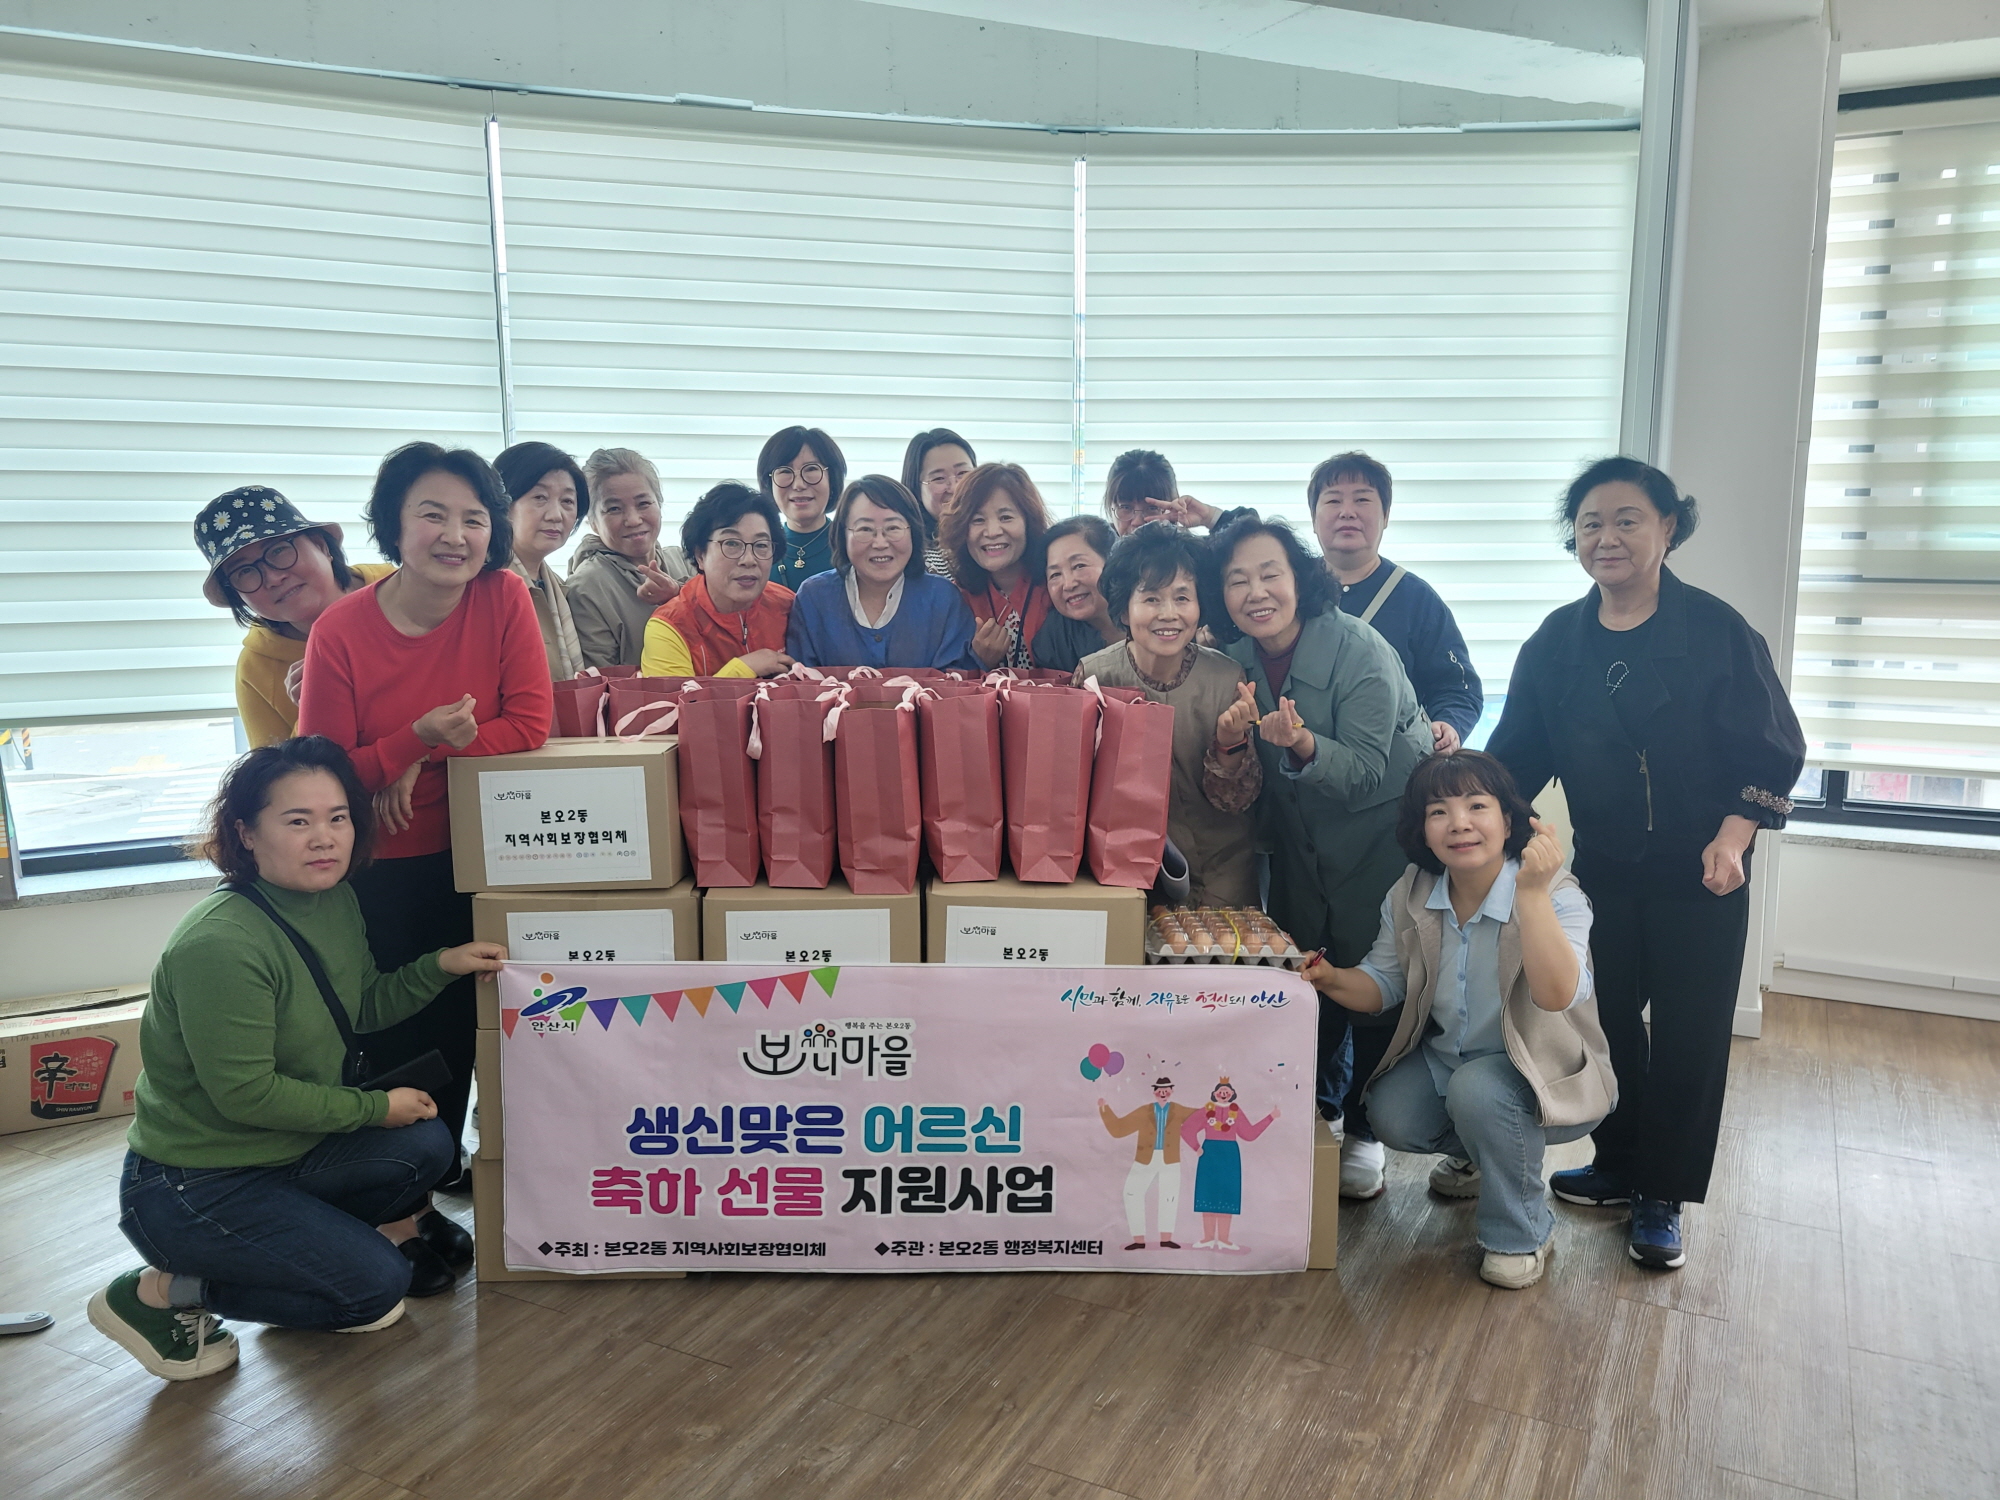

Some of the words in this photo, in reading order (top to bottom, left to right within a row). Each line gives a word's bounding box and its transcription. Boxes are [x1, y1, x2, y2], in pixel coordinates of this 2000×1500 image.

[541, 809, 588, 824] 본오2동
[505, 830, 627, 847] 지역사회보장협의체
[568, 950, 616, 962] 본오2동
[785, 950, 832, 963] 본오2동
[1003, 947, 1049, 961] 본오2동
[1060, 985, 1108, 1012] 시민과
[1145, 990, 1191, 1014] 자유로운
[1195, 991, 1246, 1013] 혁신도시
[1250, 990, 1292, 1009] 안산
[531, 1021, 575, 1032] 안산시
[844, 1021, 866, 1030] 행복을
[868, 1022, 883, 1030] 주는
[885, 1022, 911, 1030] 본오2동
[33, 1052, 78, 1100] 辛
[64, 1082, 91, 1092] 라면
[625, 1104, 844, 1156] 생신맞은
[863, 1104, 1024, 1154] 어르신
[590, 1166, 703, 1217] 축하
[717, 1166, 825, 1218] 선물
[840, 1165, 1054, 1216] 지원사업
[603, 1241, 668, 1257] 본오2동
[671, 1241, 827, 1258] 지역사회보장협의체
[938, 1240, 999, 1256] 본오2동
[1003, 1239, 1104, 1256] 행정복지센터
